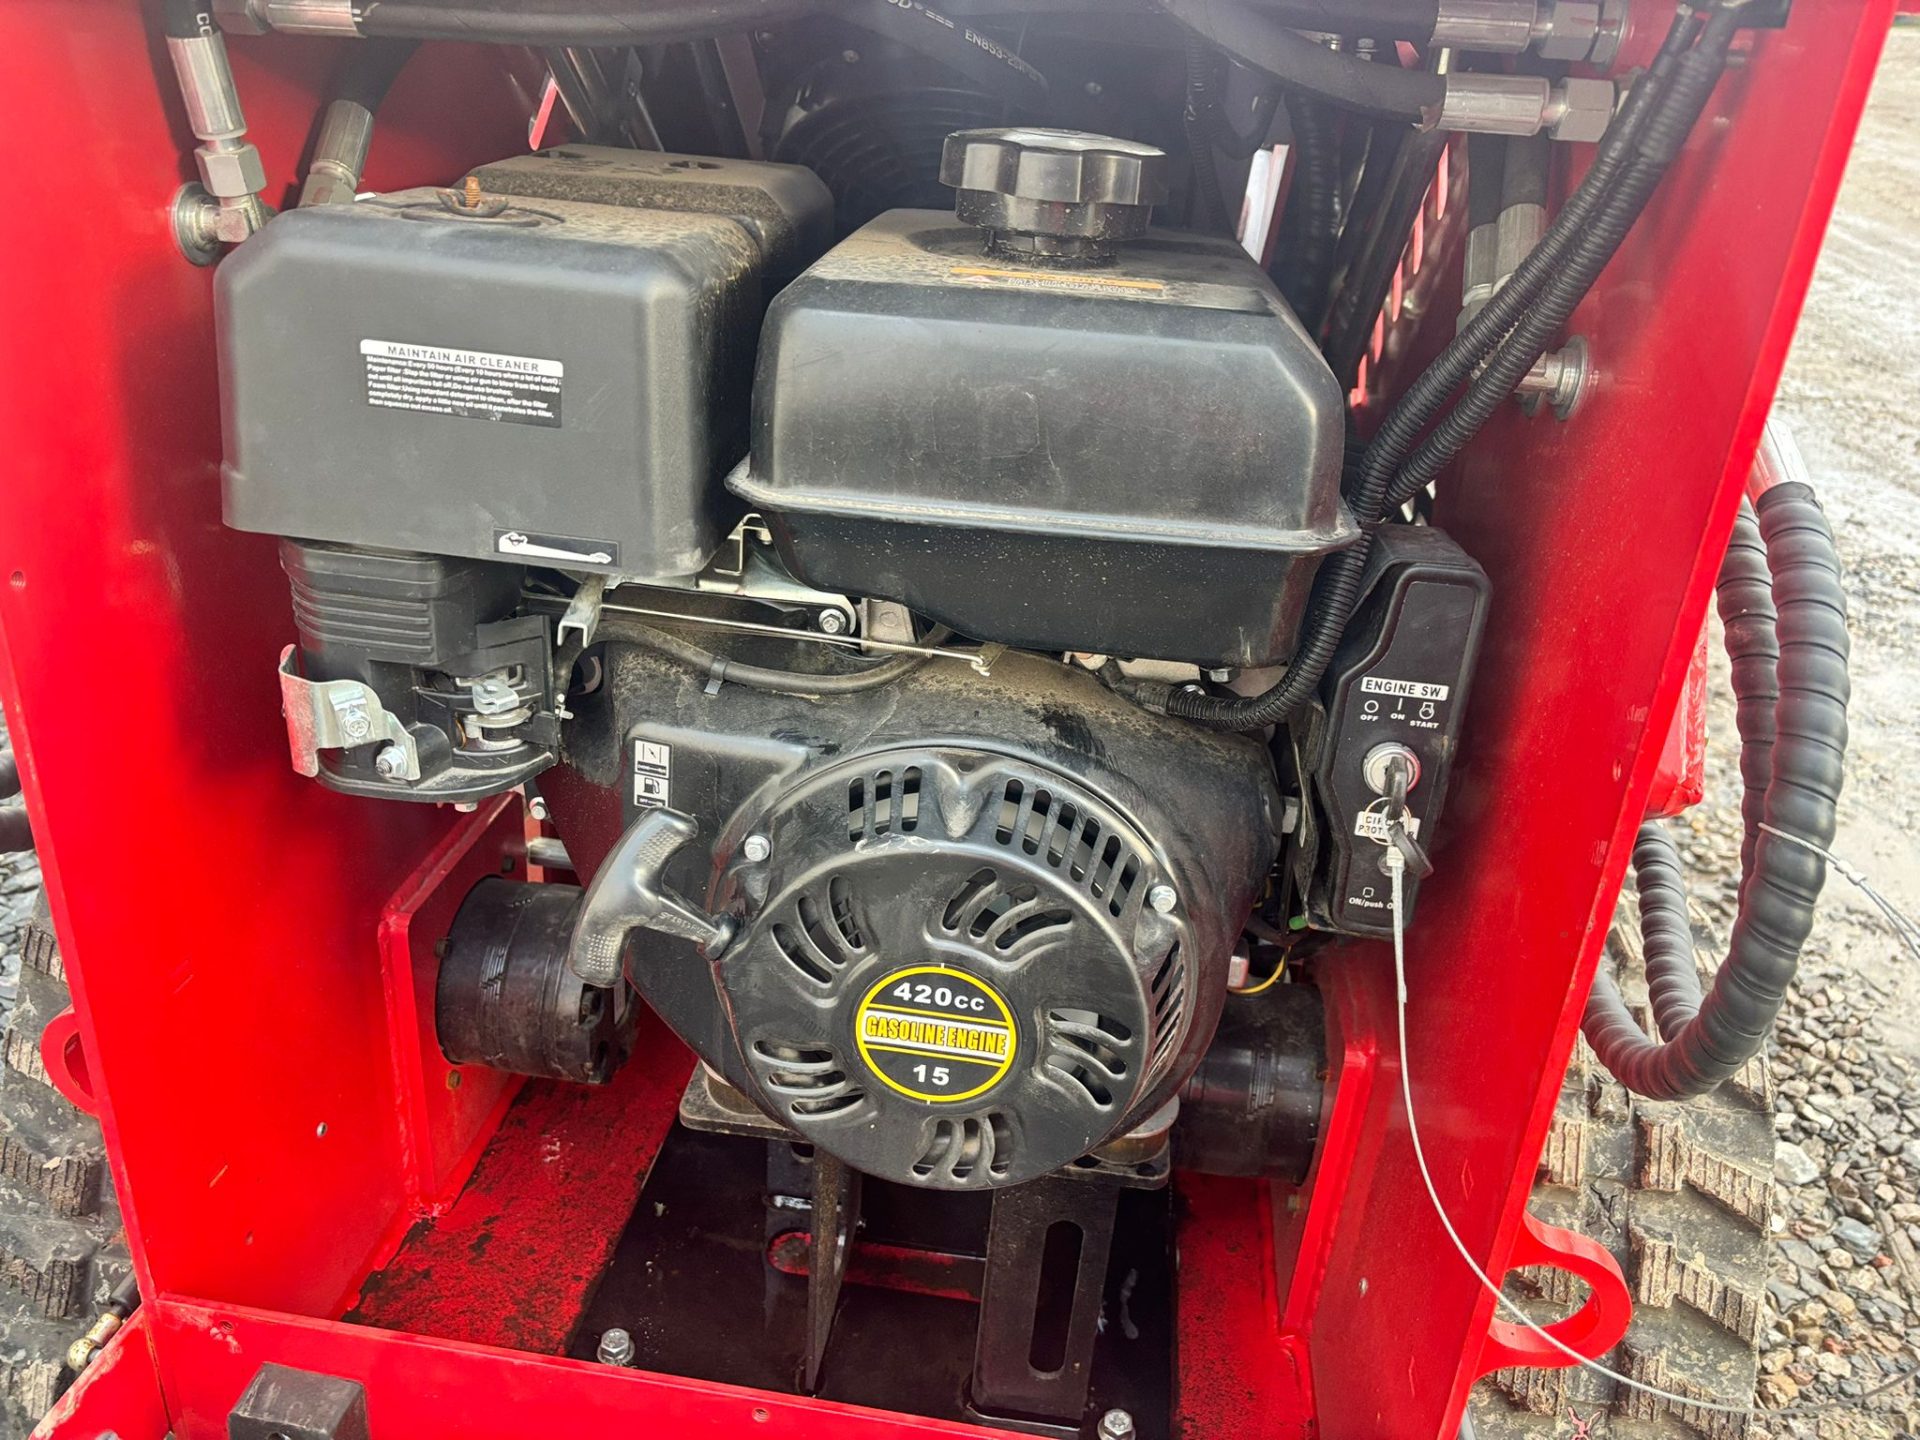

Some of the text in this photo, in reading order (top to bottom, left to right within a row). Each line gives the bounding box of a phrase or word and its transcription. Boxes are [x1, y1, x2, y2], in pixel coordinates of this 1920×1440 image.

[388, 346, 539, 373] MAINTAIN AIR CLEANER
[1365, 680, 1415, 695] ENGINE
[1360, 714, 1379, 722] OFF
[1410, 720, 1439, 729] START
[893, 982, 985, 1012] 420cc
[866, 1015, 1006, 1056] GASOLINE ENGINE
[913, 1064, 950, 1086] 15
